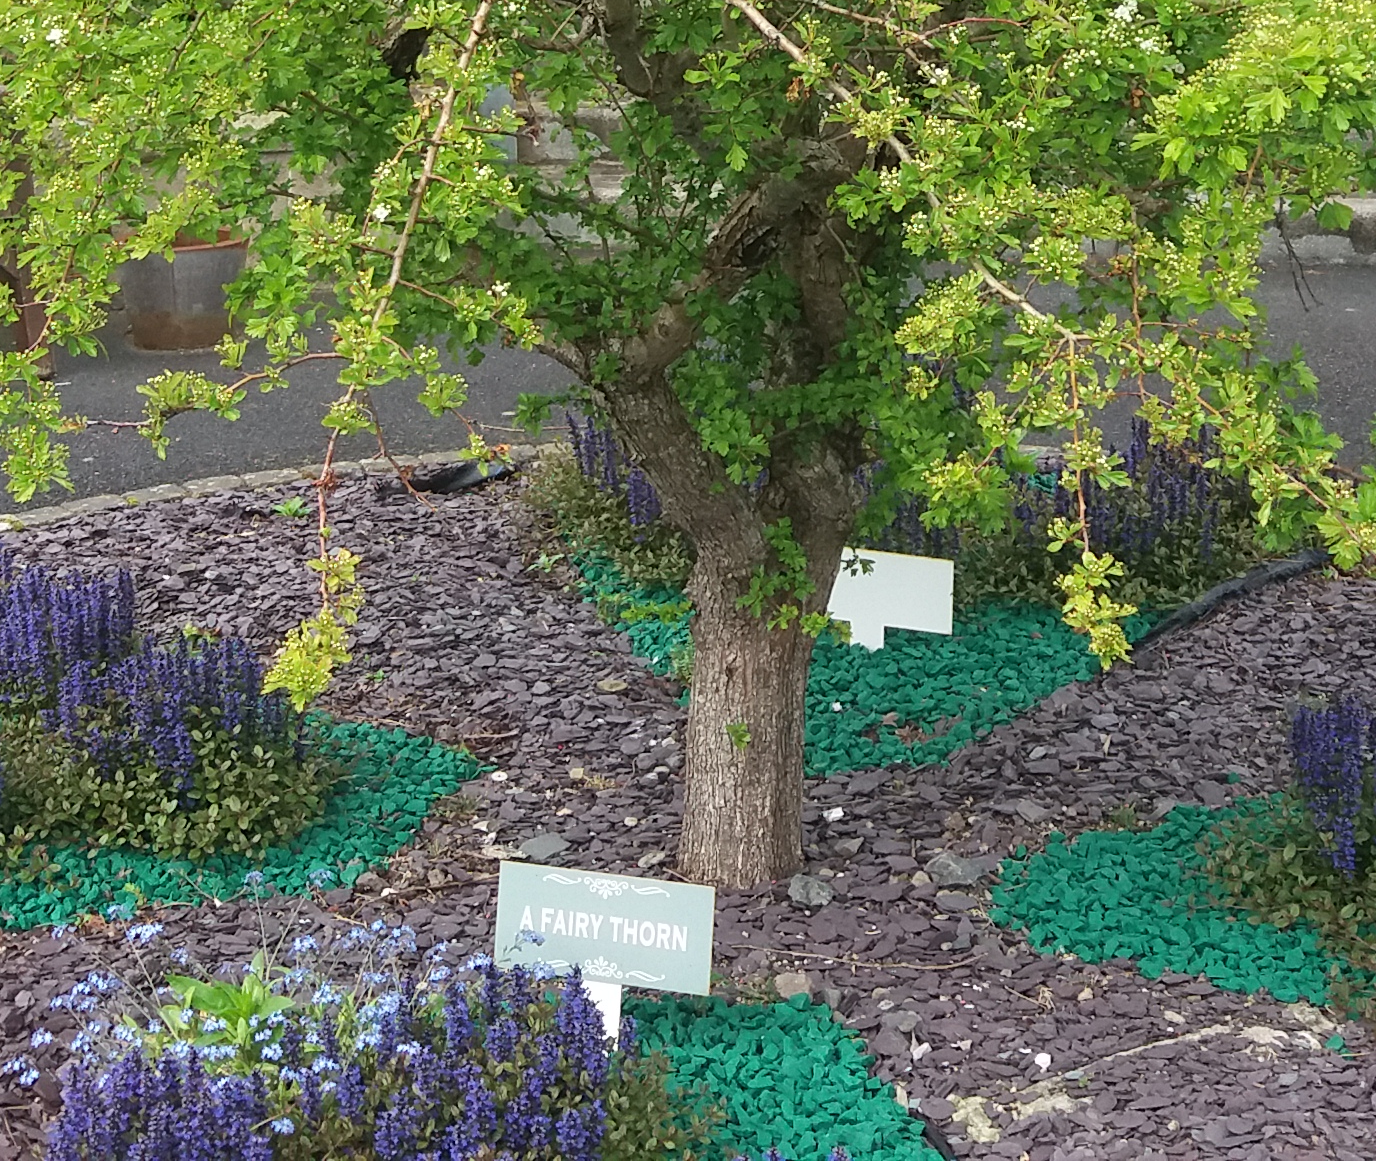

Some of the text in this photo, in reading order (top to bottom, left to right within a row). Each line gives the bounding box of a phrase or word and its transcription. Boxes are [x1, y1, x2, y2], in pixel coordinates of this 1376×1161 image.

[519, 905, 688, 952] A FAIRY THORN
